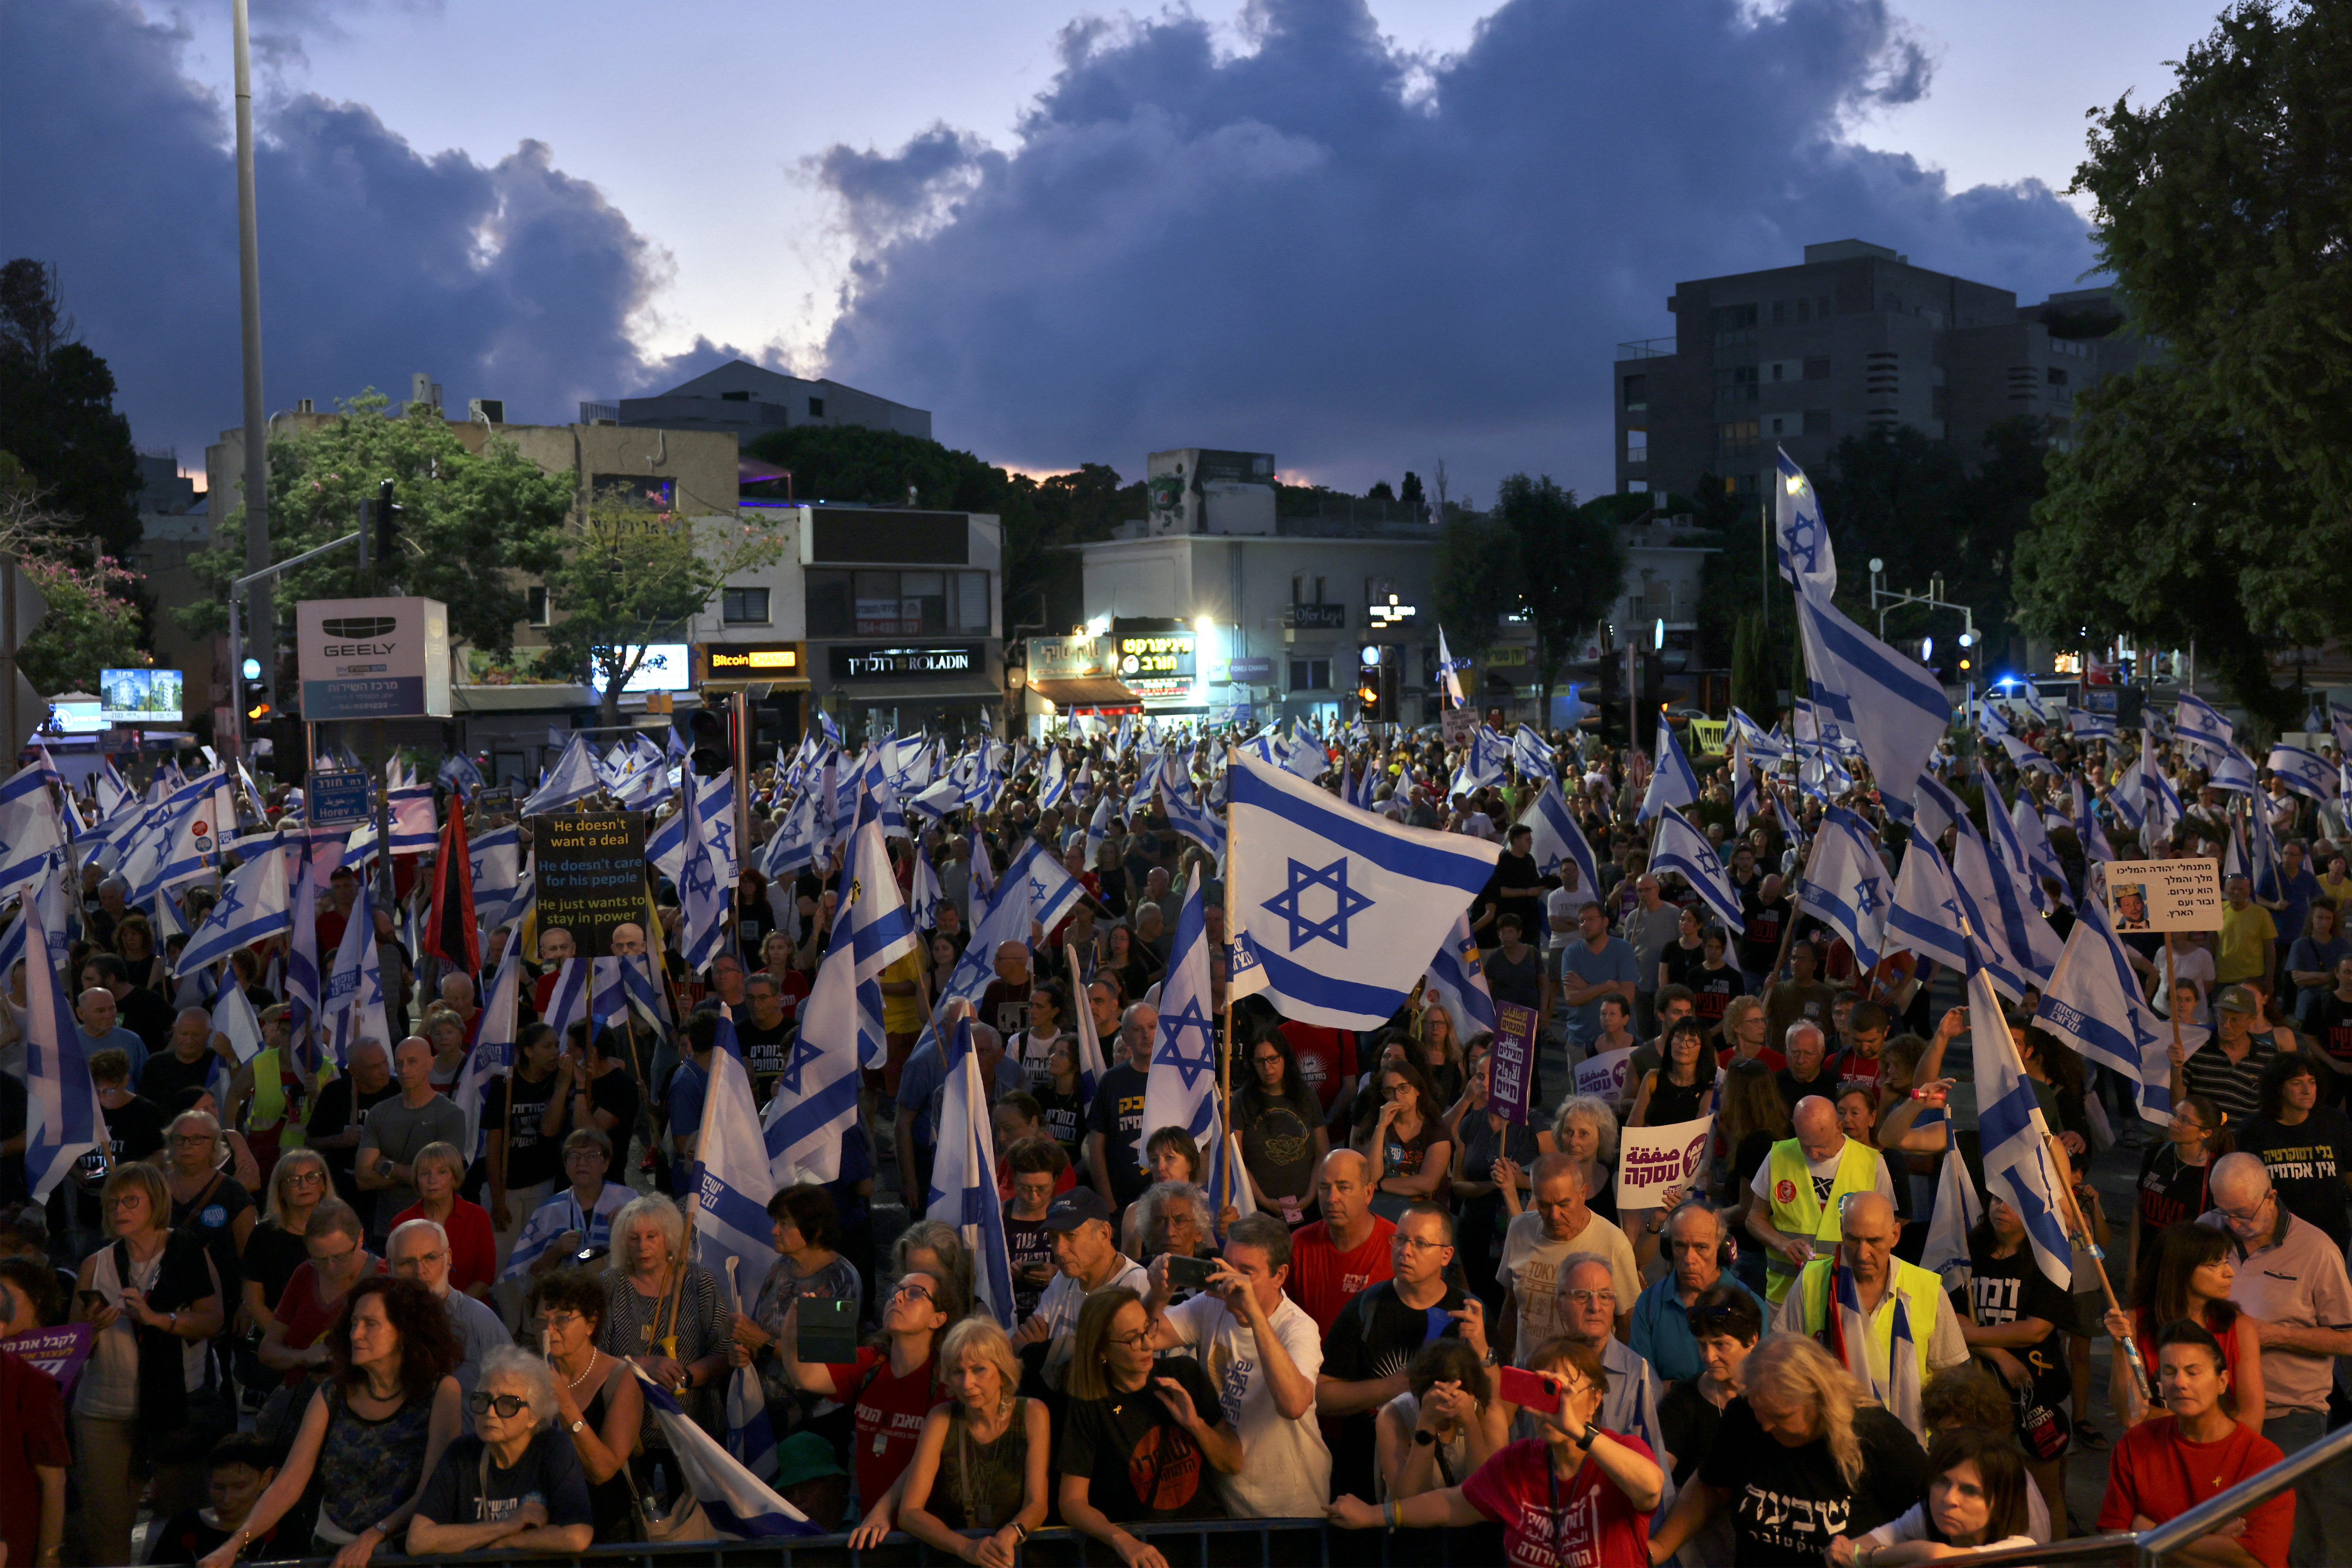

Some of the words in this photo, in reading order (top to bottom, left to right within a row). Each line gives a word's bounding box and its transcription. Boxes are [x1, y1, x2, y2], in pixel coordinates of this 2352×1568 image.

[324, 643, 396, 657] GEELY
[1122, 638, 1194, 655] מינימרקט
[713, 654, 750, 667] Bitcoin
[751, 655, 793, 664] CHANGE
[849, 652, 894, 675] רולדין
[909, 655, 969, 670] ROLADIN
[1141, 655, 1177, 671] חורב
[328, 683, 368, 692] השירות
[371, 681, 397, 690] מרכז
[318, 778, 343, 788] חורב
[319, 807, 350, 818] Horev
[554, 820, 572, 832] He
[576, 818, 626, 831] doesn't
[550, 836, 585, 848] want
[589, 837, 597, 846] a
[600, 833, 629, 845] deal
[538, 860, 556, 871] He
[561, 858, 611, 871] doesn't
[614, 857, 642, 868] care
[2117, 866, 2147, 875] המליכו
[546, 874, 566, 886] for
[569, 875, 588, 885] his
[592, 873, 637, 887] pepole
[2164, 876, 2192, 886] והמלך
[2194, 875, 2213, 884] מלך
[538, 899, 556, 910] He
[559, 898, 584, 912] just
[588, 896, 629, 909] wants
[631, 895, 645, 906] to
[547, 913, 574, 926] stay
[578, 912, 591, 923] in
[595, 909, 637, 924] power
[2167, 909, 2194, 918] הארץ.
[1502, 1019, 1526, 1035] הסכמים
[1499, 1043, 1523, 1061] מצילים
[752, 1058, 784, 1072] בחטופי
[1579, 1068, 1609, 1085] صفقة
[1496, 1078, 1518, 1100] חיים
[1626, 1147, 1681, 1164] صفقة
[2263, 1147, 2313, 1163] דמוקרטיה
[2314, 1145, 2334, 1159] בלי
[1624, 1163, 1680, 1188] עסקה
[2315, 1161, 2337, 1178] אין
[1529, 1261, 1557, 1281] TOKY
[19, 1339, 40, 1351] את
[44, 1332, 77, 1349] לקבל
[37, 1347, 74, 1359] לעצור
[1235, 1360, 1253, 1372] עם
[891, 1412, 925, 1430] מאבק
